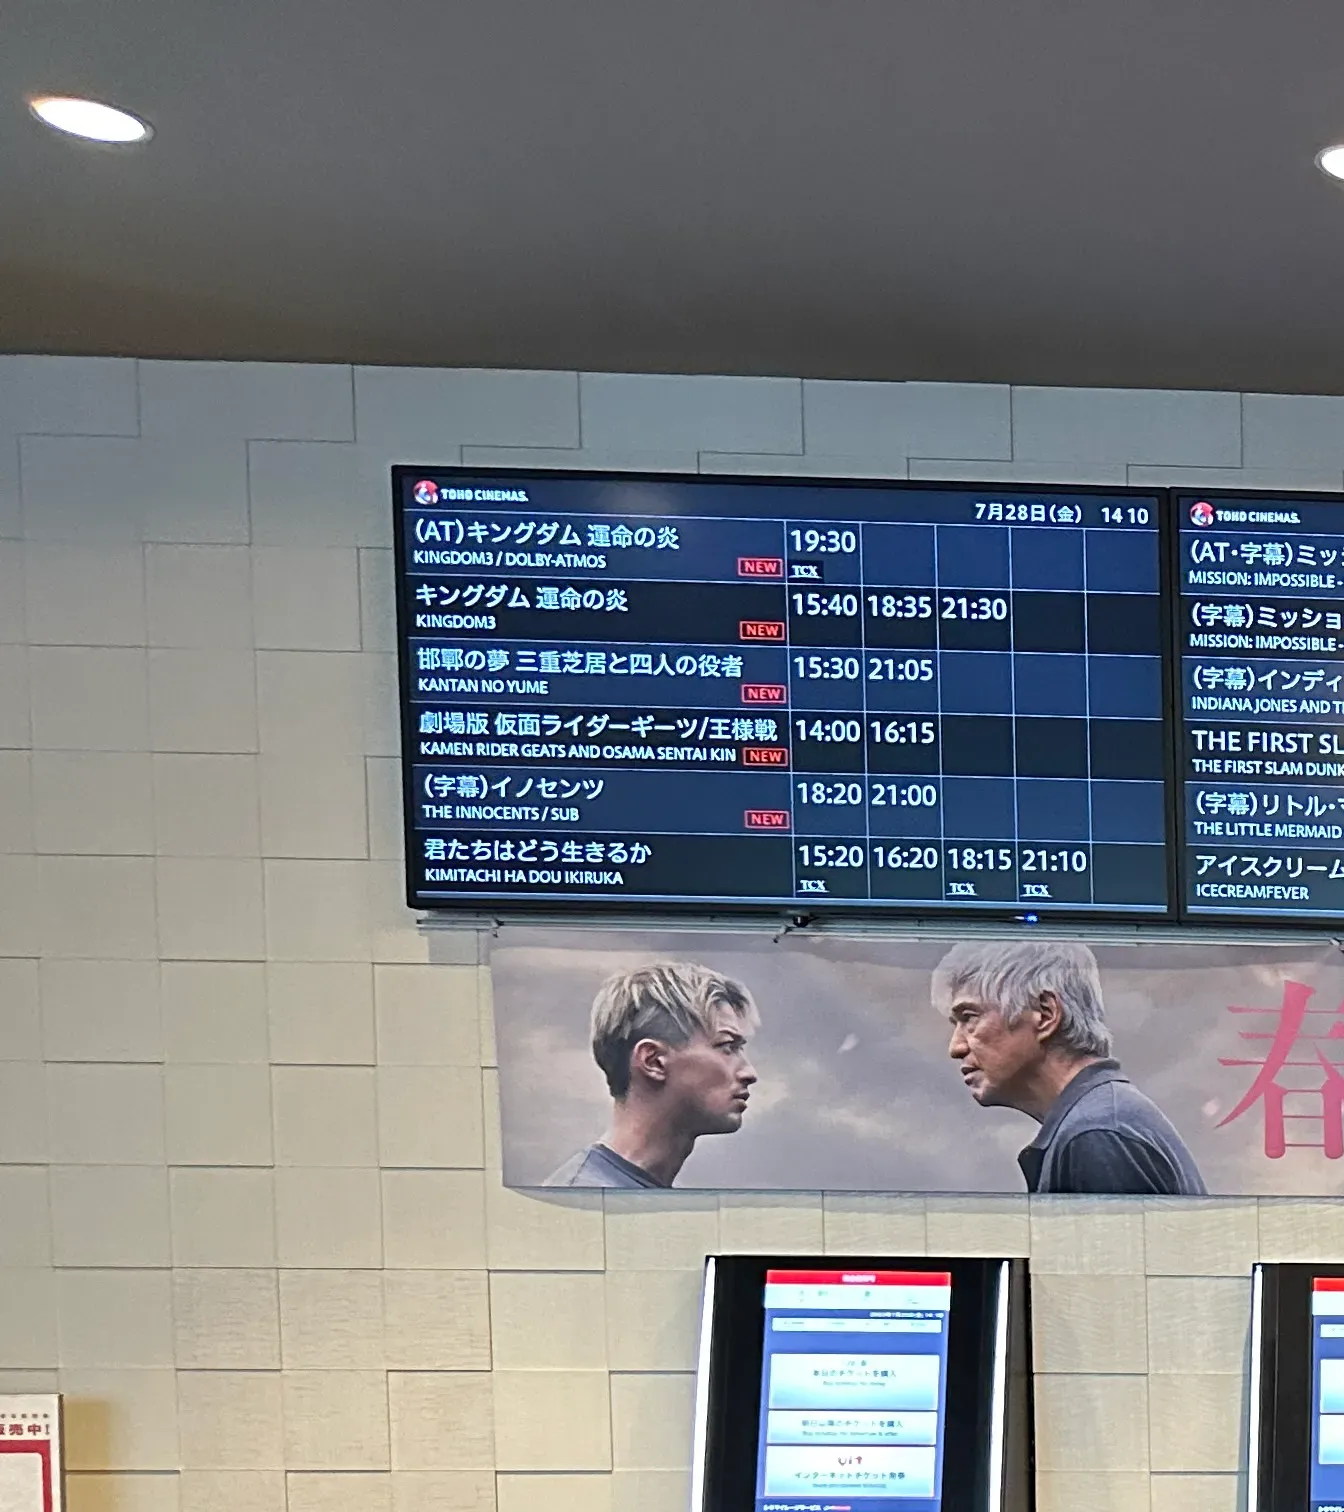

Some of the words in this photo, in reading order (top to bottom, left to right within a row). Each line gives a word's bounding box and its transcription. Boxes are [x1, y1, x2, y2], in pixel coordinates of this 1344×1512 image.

[441, 489, 473, 500] TOHO
[415, 518, 581, 546] (AT)キングダム
[588, 524, 679, 550] 運命の炎
[790, 529, 856, 552] 19:30
[414, 551, 493, 566] KINGDOM3
[505, 553, 606, 569] DOLBY-ATMOS
[745, 562, 777, 573] NEW
[1189, 570, 1252, 586] MISSION:
[1254, 572, 1335, 589] IMPOSSIBLE
[416, 584, 530, 608] キングダム
[536, 588, 628, 612] 運命の炎
[792, 594, 858, 616] 15:40
[868, 595, 932, 618] 18:35
[942, 597, 1007, 620] 21:30
[416, 615, 496, 629] KINGDOM3
[746, 625, 779, 637] NEW
[516, 651, 743, 678] 三重芝居と四人の役者
[794, 657, 859, 679] 15:30
[868, 658, 933, 681] 21:05
[418, 678, 479, 693] KANTAN
[482, 680, 503, 693] NO
[507, 681, 549, 694] YUME
[419, 712, 488, 735] 劇場版
[495, 712, 778, 742] 仮面ライダーギーツ/王様戦
[796, 720, 861, 742] 14:00
[871, 722, 935, 744] 16:15
[421, 742, 473, 756] KAMEN
[476, 743, 519, 757] RIDER
[522, 744, 566, 758] GEATS
[568, 745, 601, 759] AND
[603, 746, 655, 760] OSAMA
[658, 748, 707, 761] SENTAI
[712, 748, 736, 762] KIN
[1192, 729, 1242, 752] THE
[1248, 731, 1313, 754] FIRST
[423, 774, 604, 800] (字幕)イノセンツ
[798, 782, 862, 805] 18:20
[872, 784, 937, 806] 21:00
[424, 838, 652, 864] 君たちはどう生きるか
[799, 845, 864, 868] 15:20
[873, 847, 938, 869] 16:20
[948, 848, 1012, 871] 18:15
[1022, 850, 1087, 872] 21:10
[1196, 884, 1309, 900] ICECREAMFEVER
